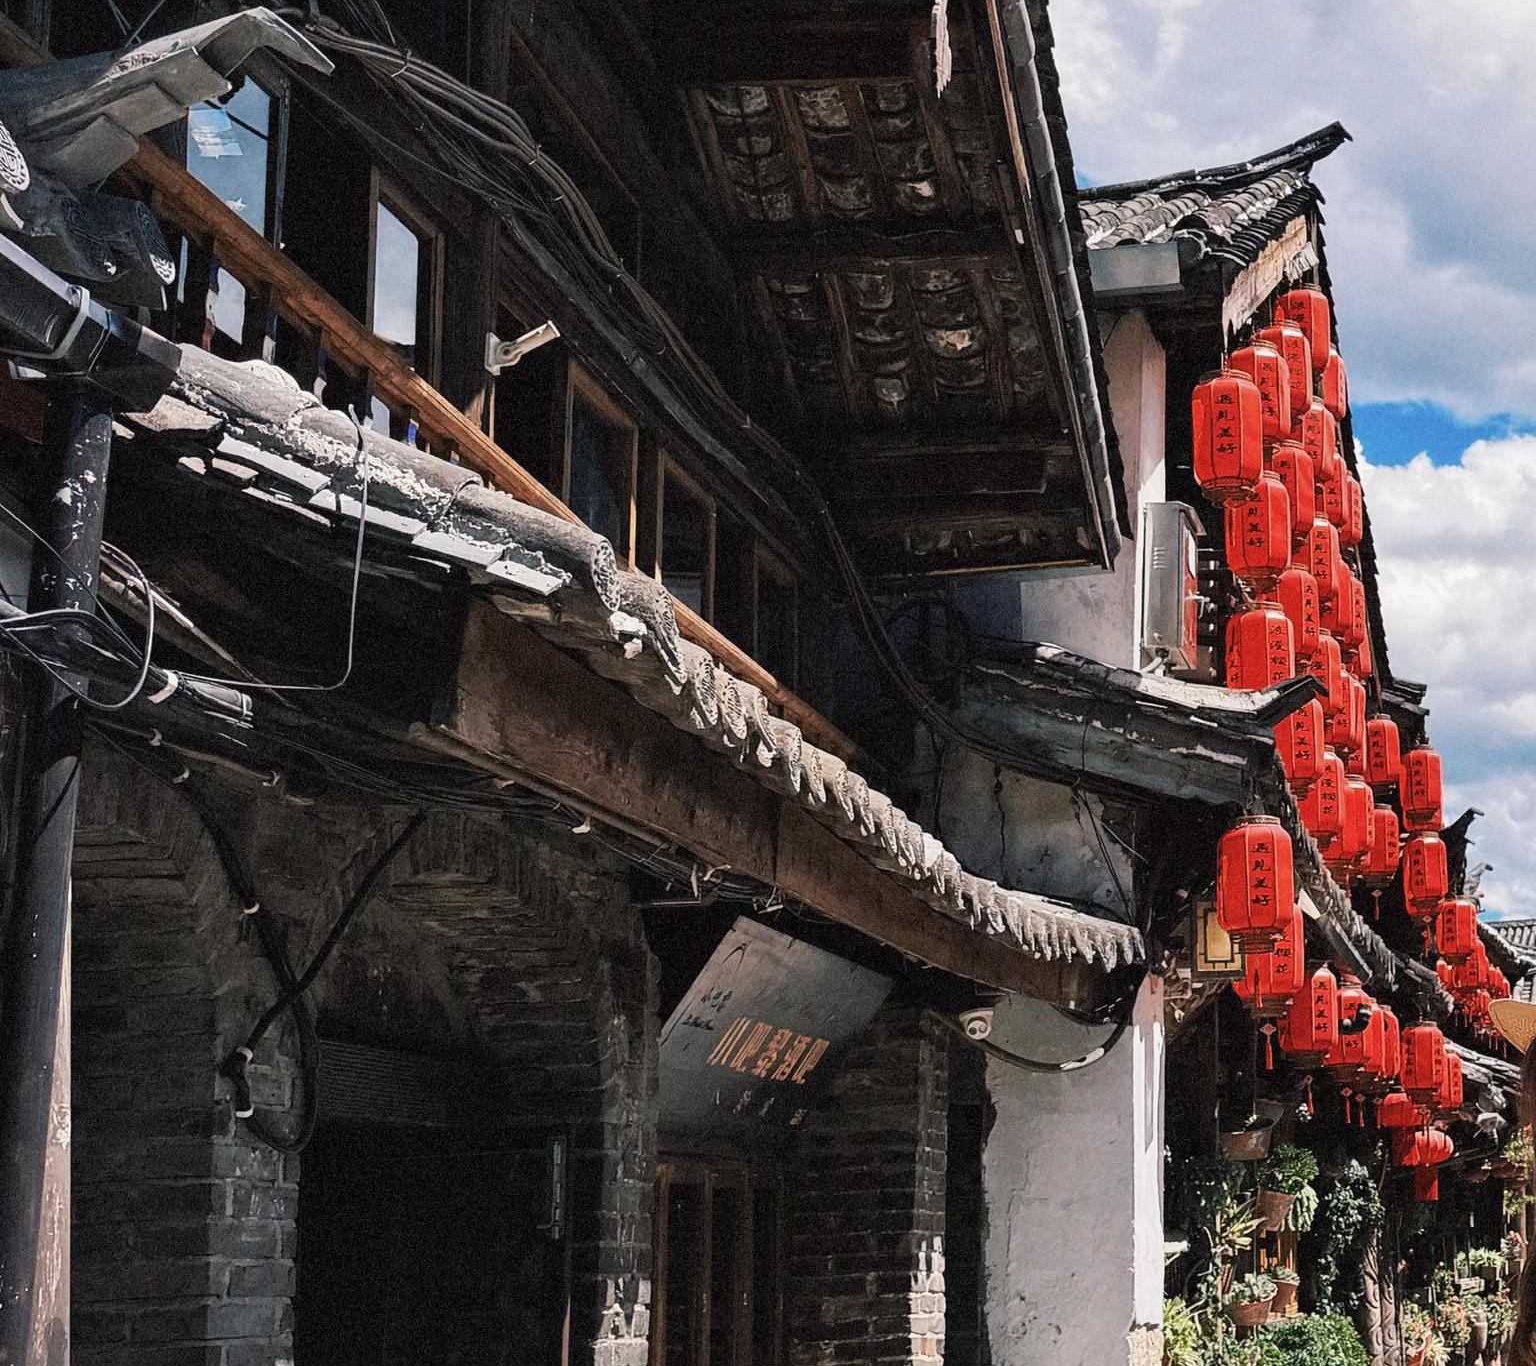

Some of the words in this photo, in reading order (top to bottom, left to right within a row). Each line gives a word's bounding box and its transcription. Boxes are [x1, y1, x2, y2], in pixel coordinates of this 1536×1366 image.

[1215, 394, 1238, 454] 遇见美好
[1250, 842, 1274, 907] 遇见美好
